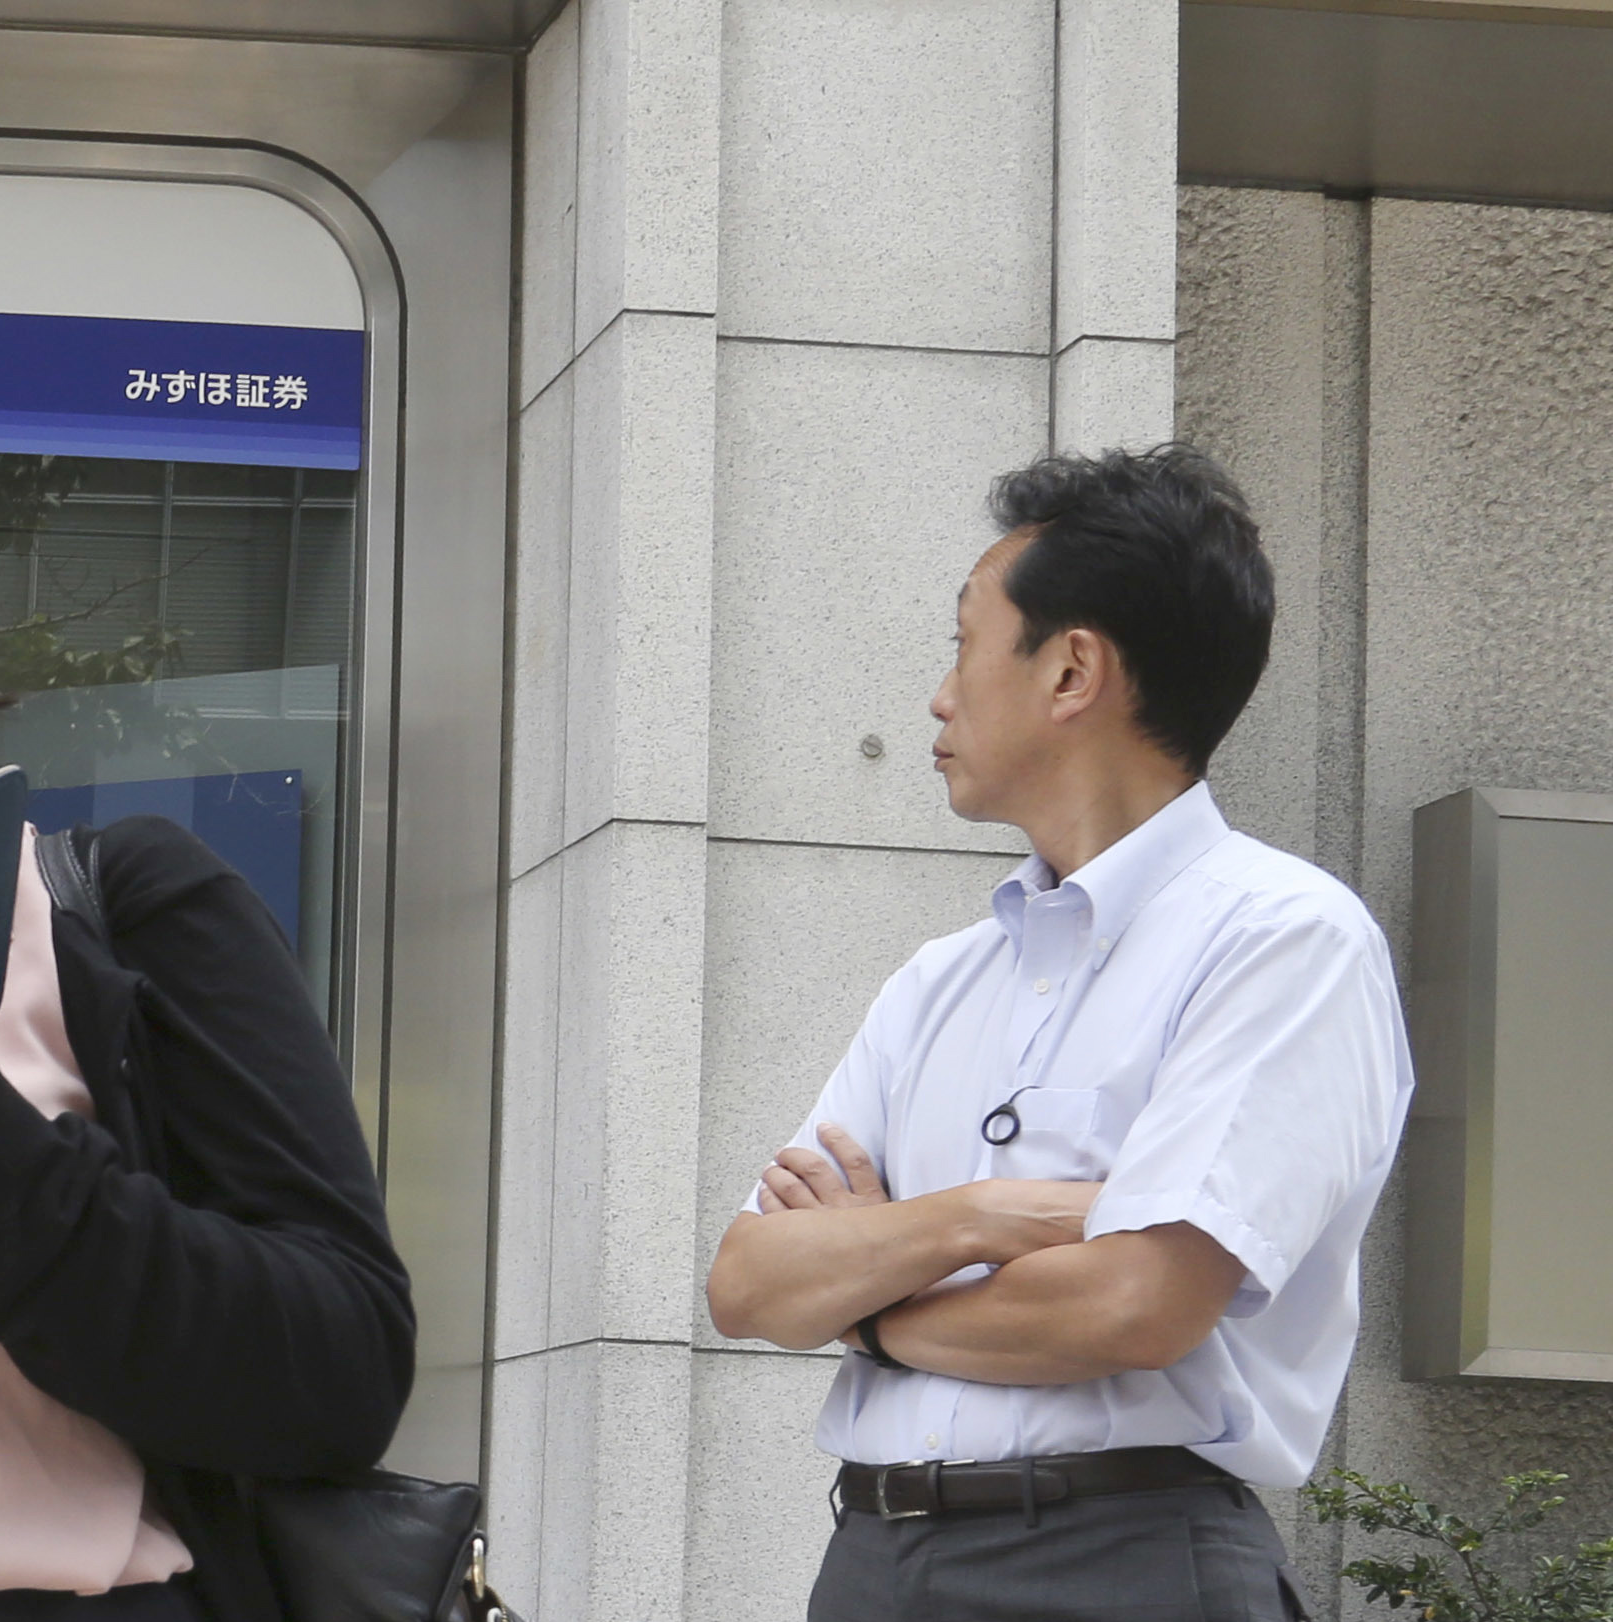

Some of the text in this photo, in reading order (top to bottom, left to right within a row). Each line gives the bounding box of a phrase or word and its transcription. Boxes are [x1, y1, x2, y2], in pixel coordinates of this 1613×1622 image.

[125, 369, 308, 410] みずほ証券
